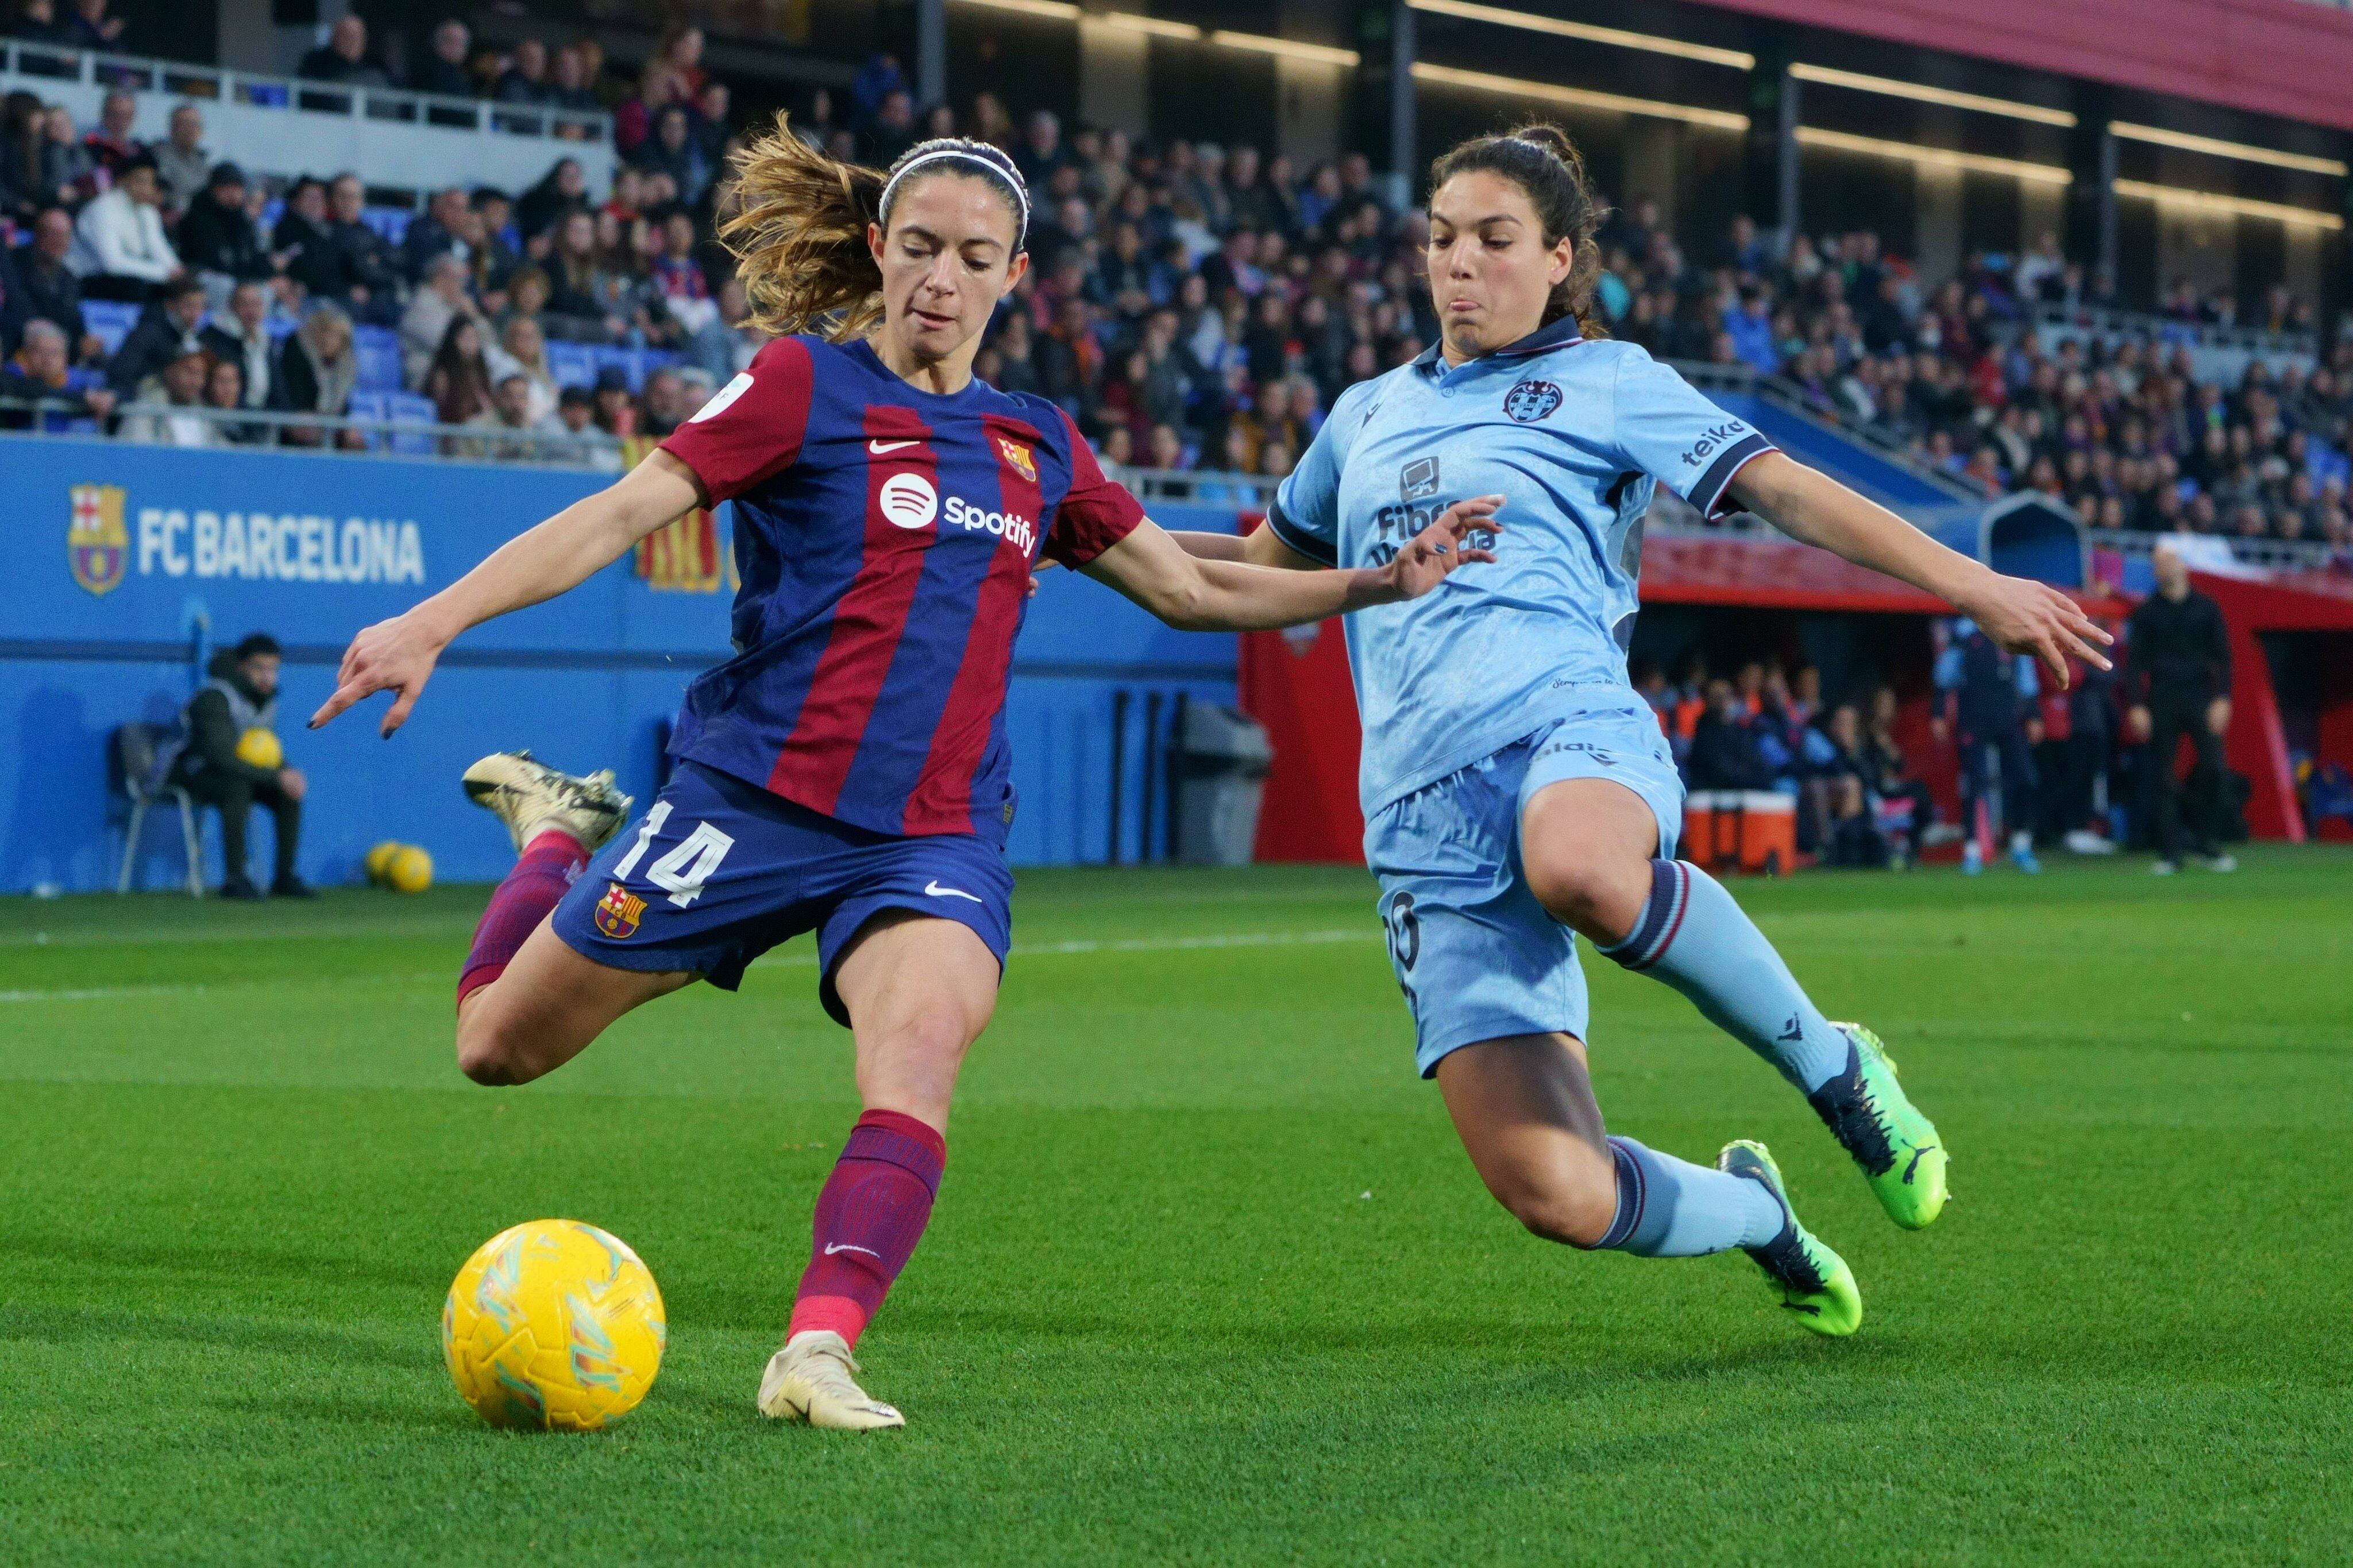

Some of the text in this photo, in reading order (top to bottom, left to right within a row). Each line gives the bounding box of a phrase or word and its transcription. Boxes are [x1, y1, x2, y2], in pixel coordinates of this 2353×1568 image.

[138, 508, 426, 585] FC BARCELONA
[944, 496, 1036, 558] Spotify
[1378, 500, 1461, 543] Fibr
[613, 800, 735, 909] 14
[1382, 892, 1420, 972] 0
